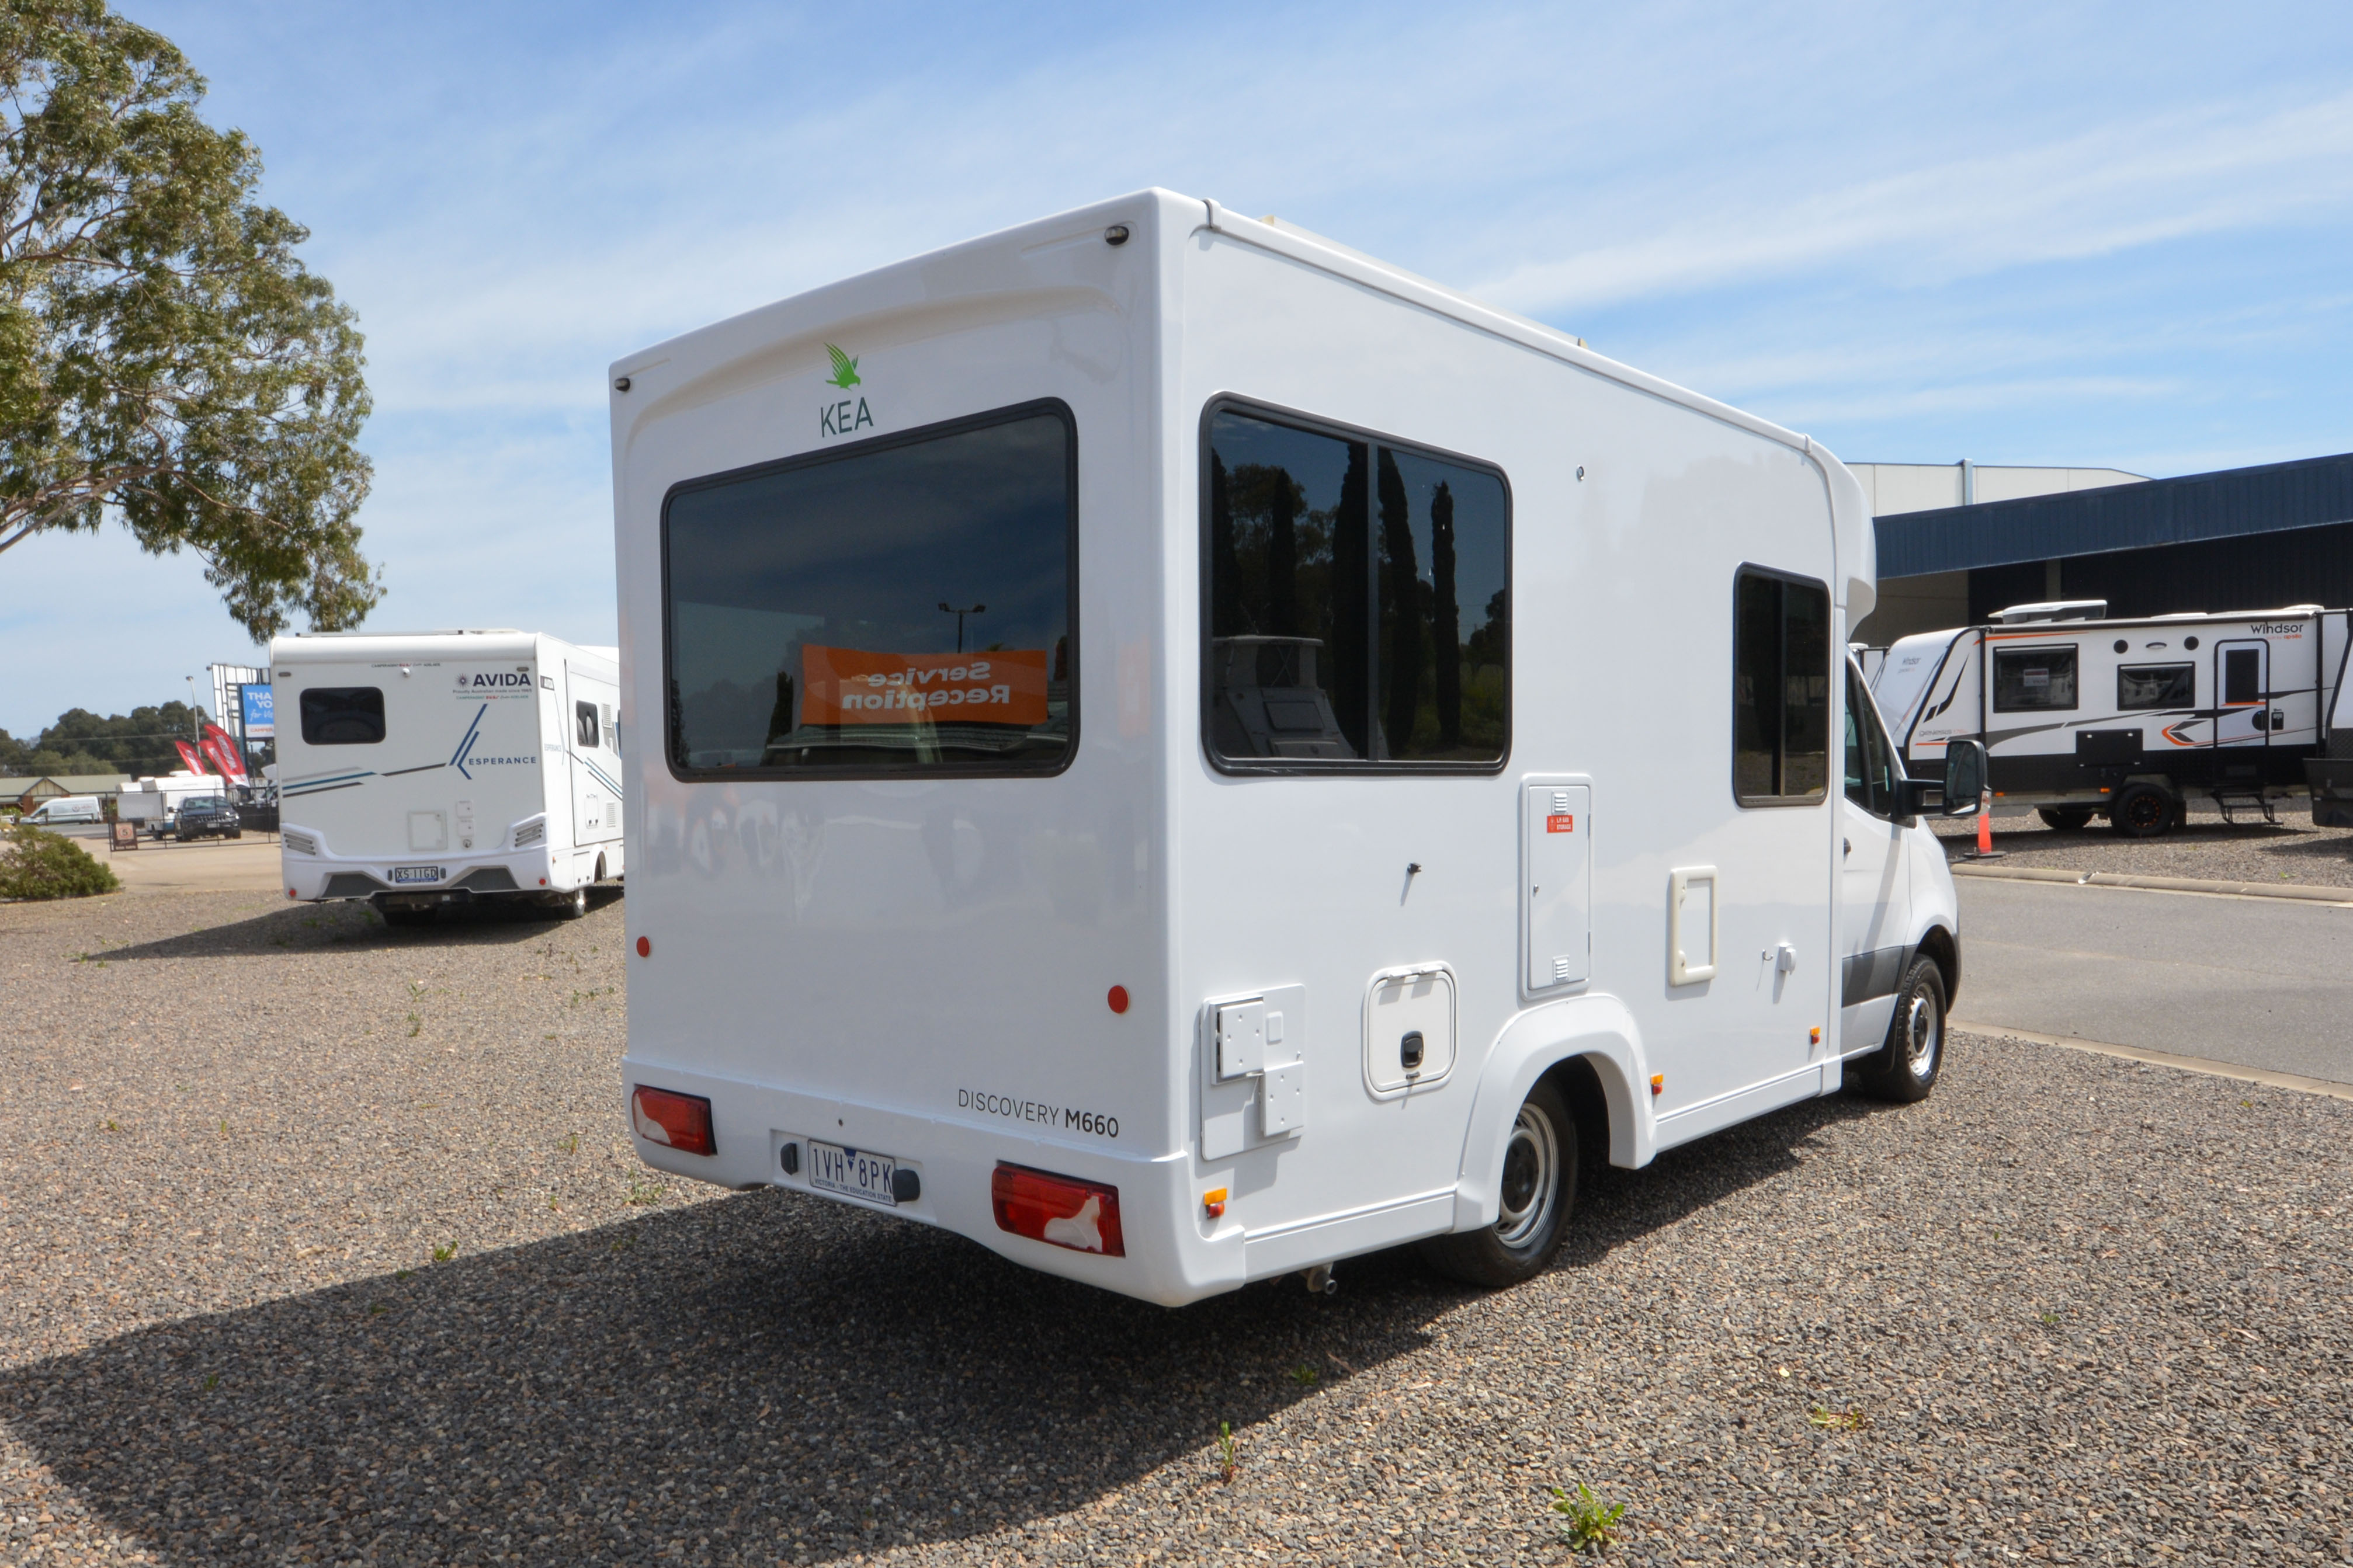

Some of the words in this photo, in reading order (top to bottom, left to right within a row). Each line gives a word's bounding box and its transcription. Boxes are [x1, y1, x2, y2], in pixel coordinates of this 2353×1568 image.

[820, 397, 874, 438] KEA
[2250, 623, 2303, 634] Windsor
[473, 673, 532, 687] AVIDA
[468, 756, 536, 766] ESPERANCE
[122, 829, 129, 837] 5
[959, 1089, 1059, 1126] DISCOVERY
[1065, 1108, 1119, 1138] M660
[815, 1177, 836, 1189] VICTORIA
[839, 1184, 849, 1192] THE
[849, 1186, 877, 1199] EDUCATION
[877, 1192, 892, 1202] STATE
